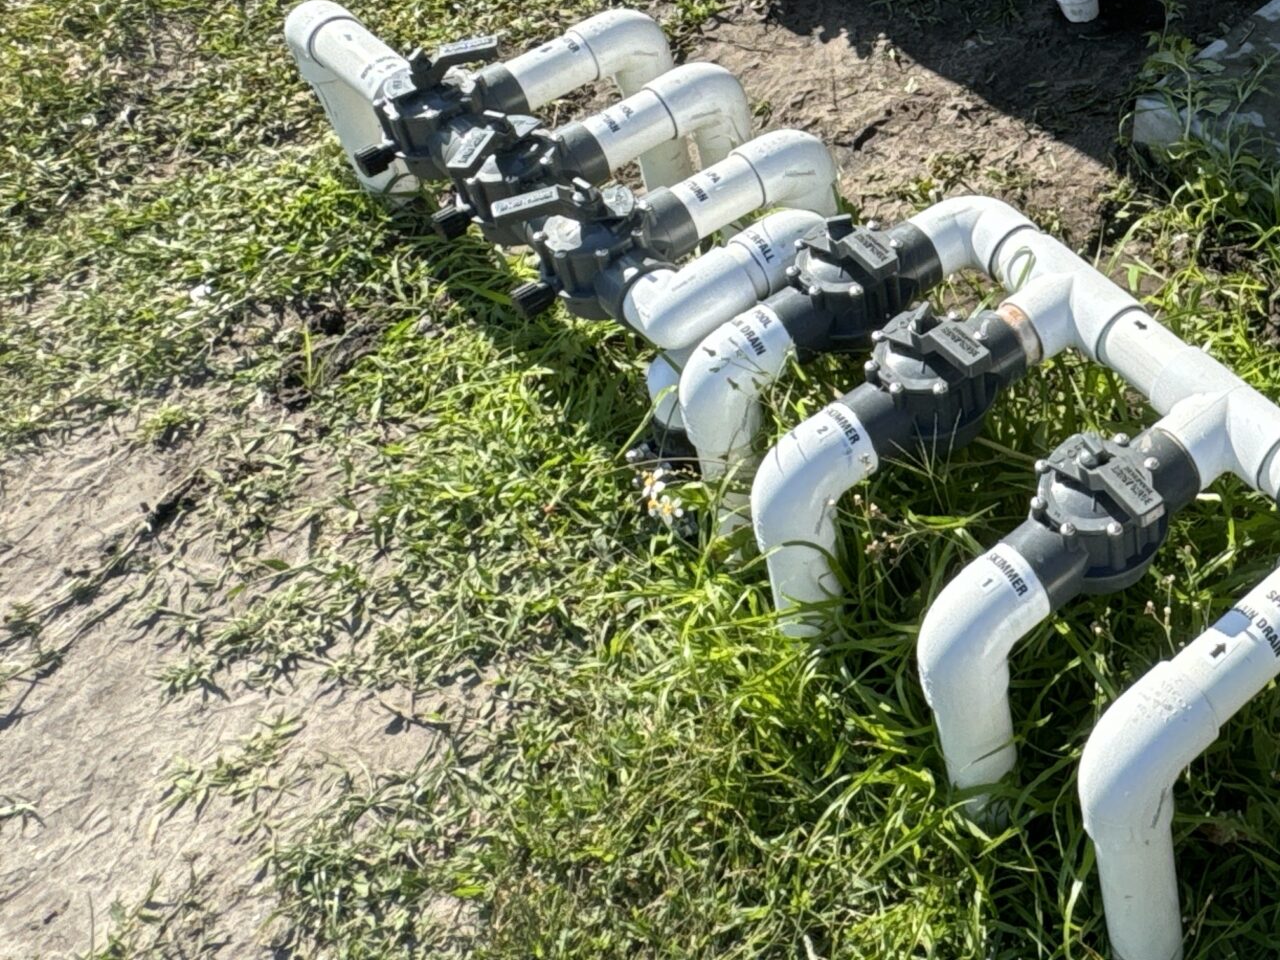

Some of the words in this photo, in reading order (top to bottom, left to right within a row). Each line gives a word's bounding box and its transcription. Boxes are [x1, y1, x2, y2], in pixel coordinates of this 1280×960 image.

[739, 324, 767, 356] DRAIN
[816, 425, 829, 435] 2
[987, 552, 1028, 596] SKIMMER
